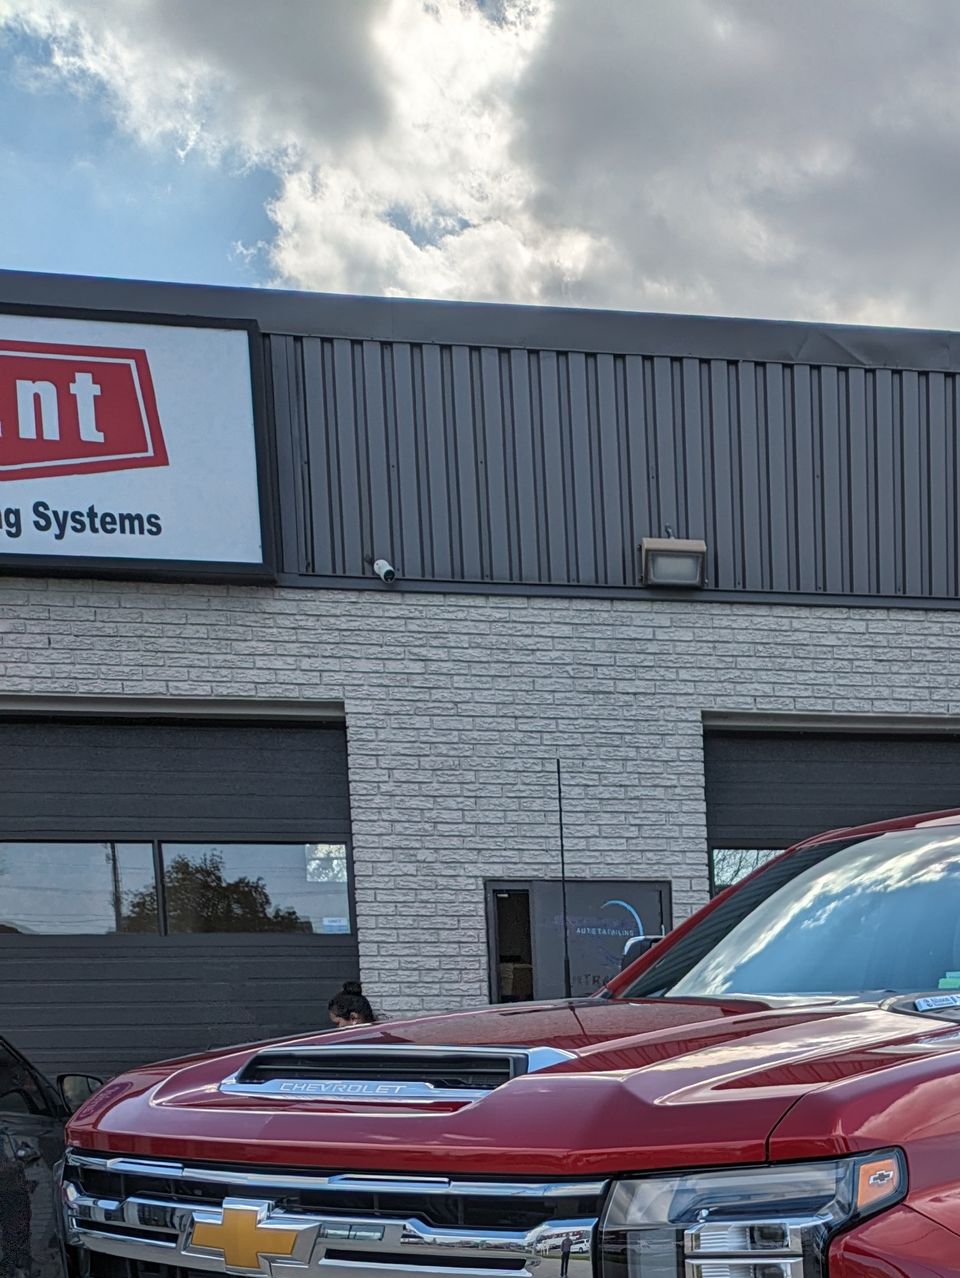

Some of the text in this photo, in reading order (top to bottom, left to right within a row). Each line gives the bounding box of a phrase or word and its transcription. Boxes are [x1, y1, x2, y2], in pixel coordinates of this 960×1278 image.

[0, 372, 104, 443] nt
[32, 501, 162, 540] Systems
[279, 1082, 408, 1096] CHEVROLET
